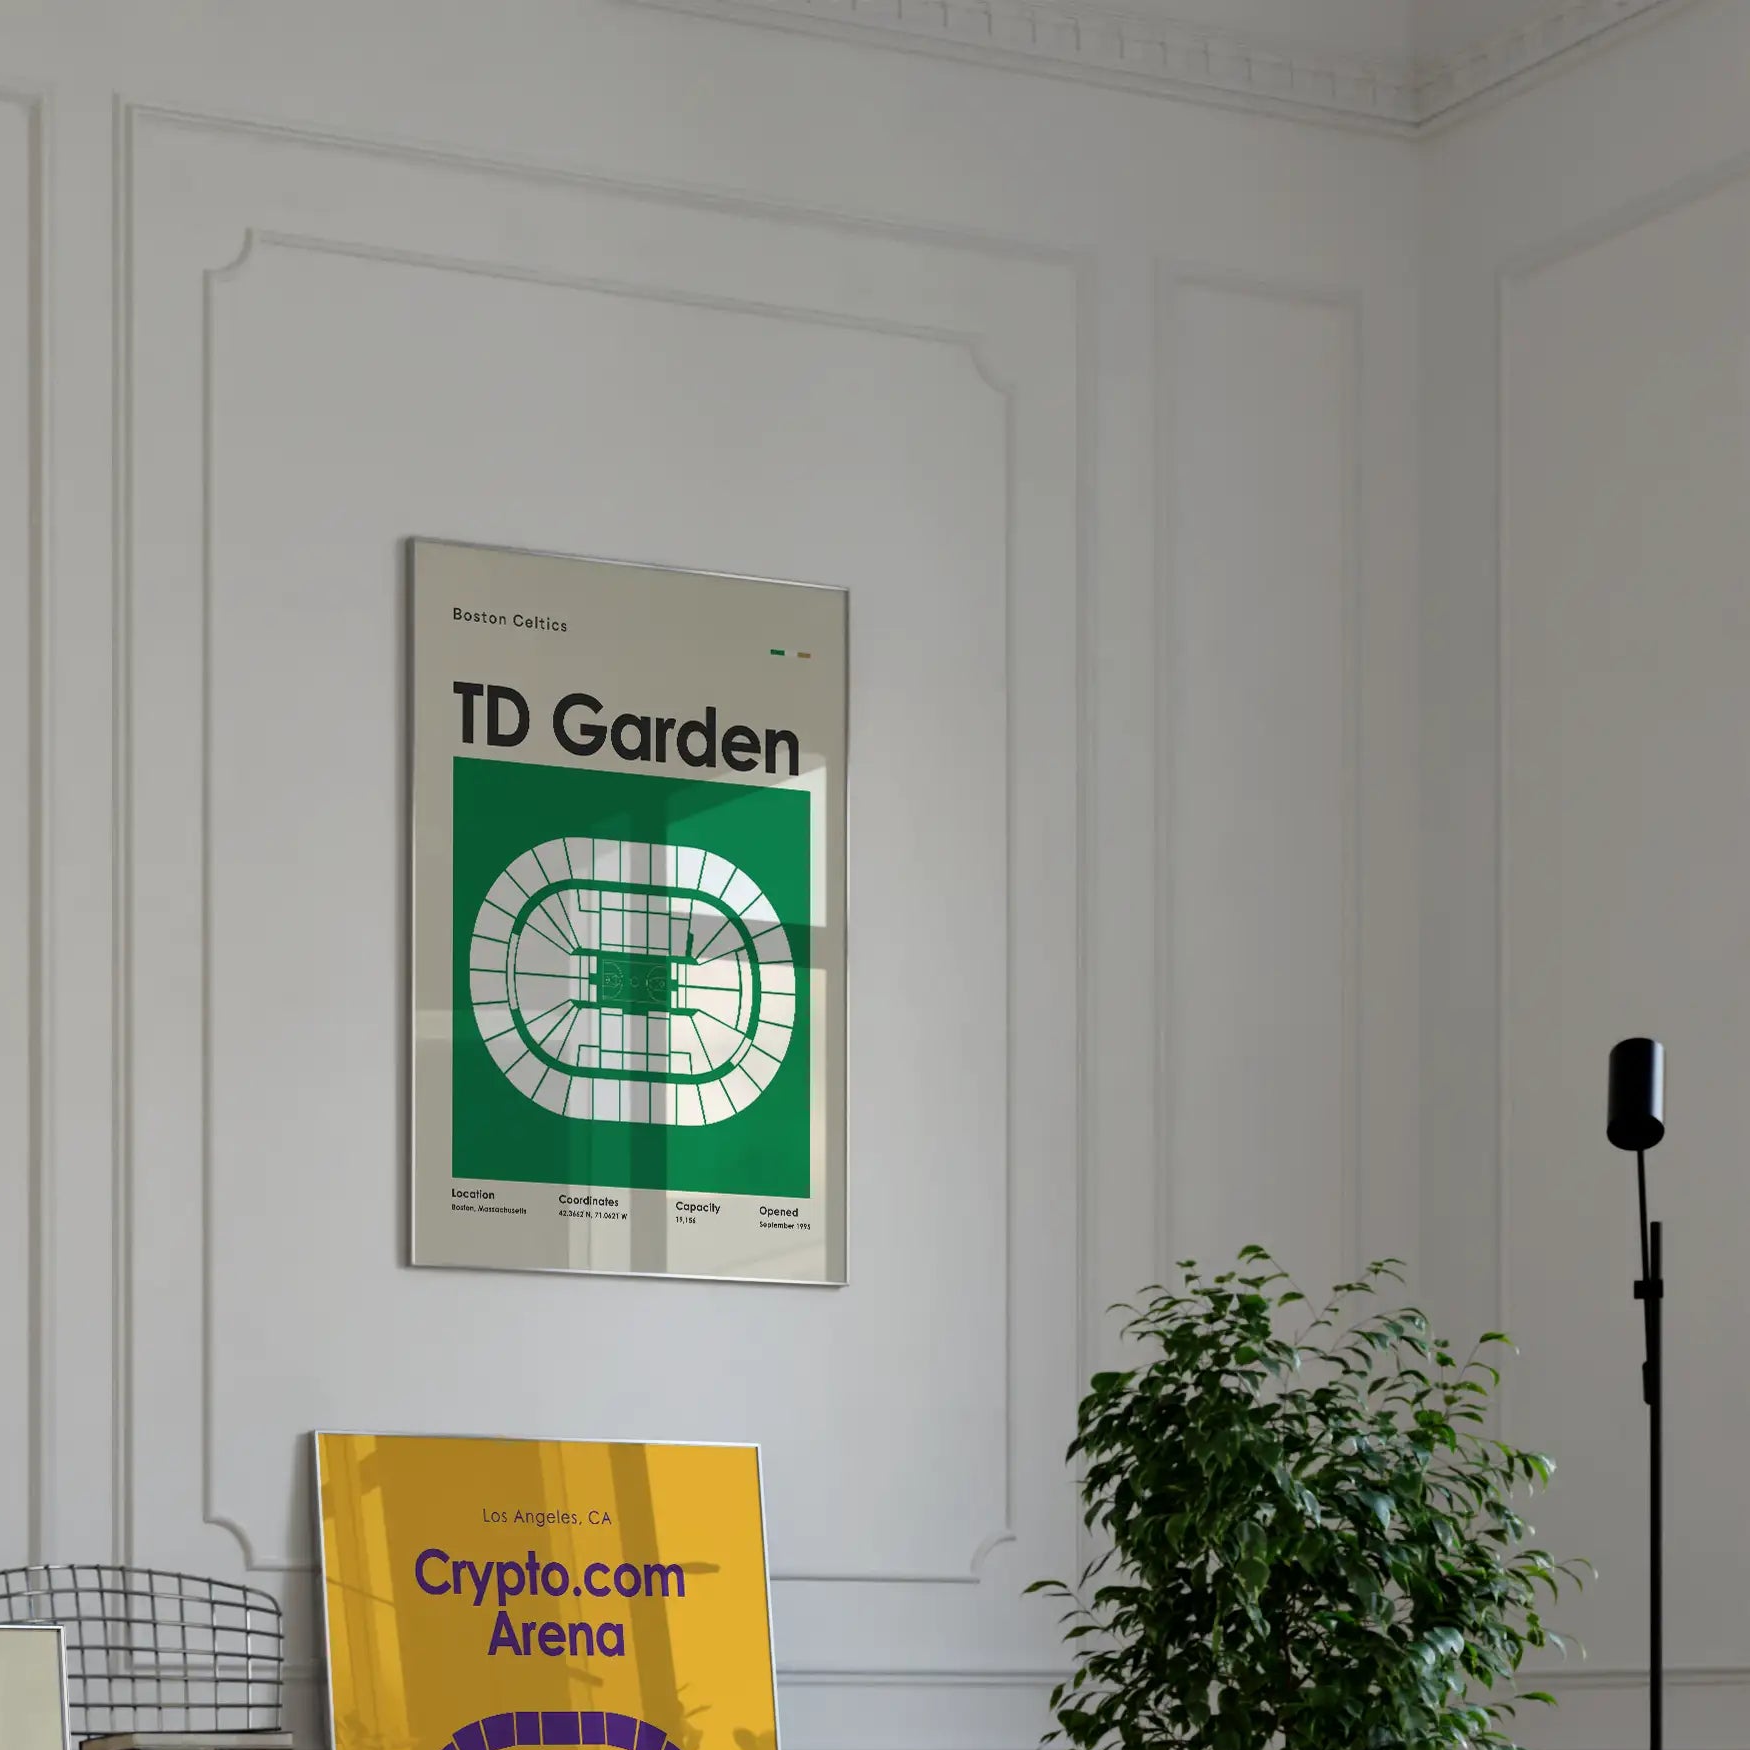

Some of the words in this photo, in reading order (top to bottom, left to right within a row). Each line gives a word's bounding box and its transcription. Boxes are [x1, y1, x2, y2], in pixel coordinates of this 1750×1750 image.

[453, 607, 507, 626] Boston
[512, 614, 567, 633] Celtics
[452, 680, 531, 748] TD
[552, 692, 800, 777] Garden
[451, 1188, 495, 1200] Location
[558, 1194, 619, 1208] Coordinates
[451, 1203, 477, 1213] Boston,
[675, 1201, 721, 1215] Capacity
[759, 1205, 799, 1218] Opened
[759, 1220, 795, 1230] September
[482, 1508, 508, 1523] Los
[513, 1509, 583, 1528] Angeles,
[587, 1510, 612, 1526] CA
[414, 1548, 687, 1607] Crypto.com
[487, 1609, 626, 1658] Arena
